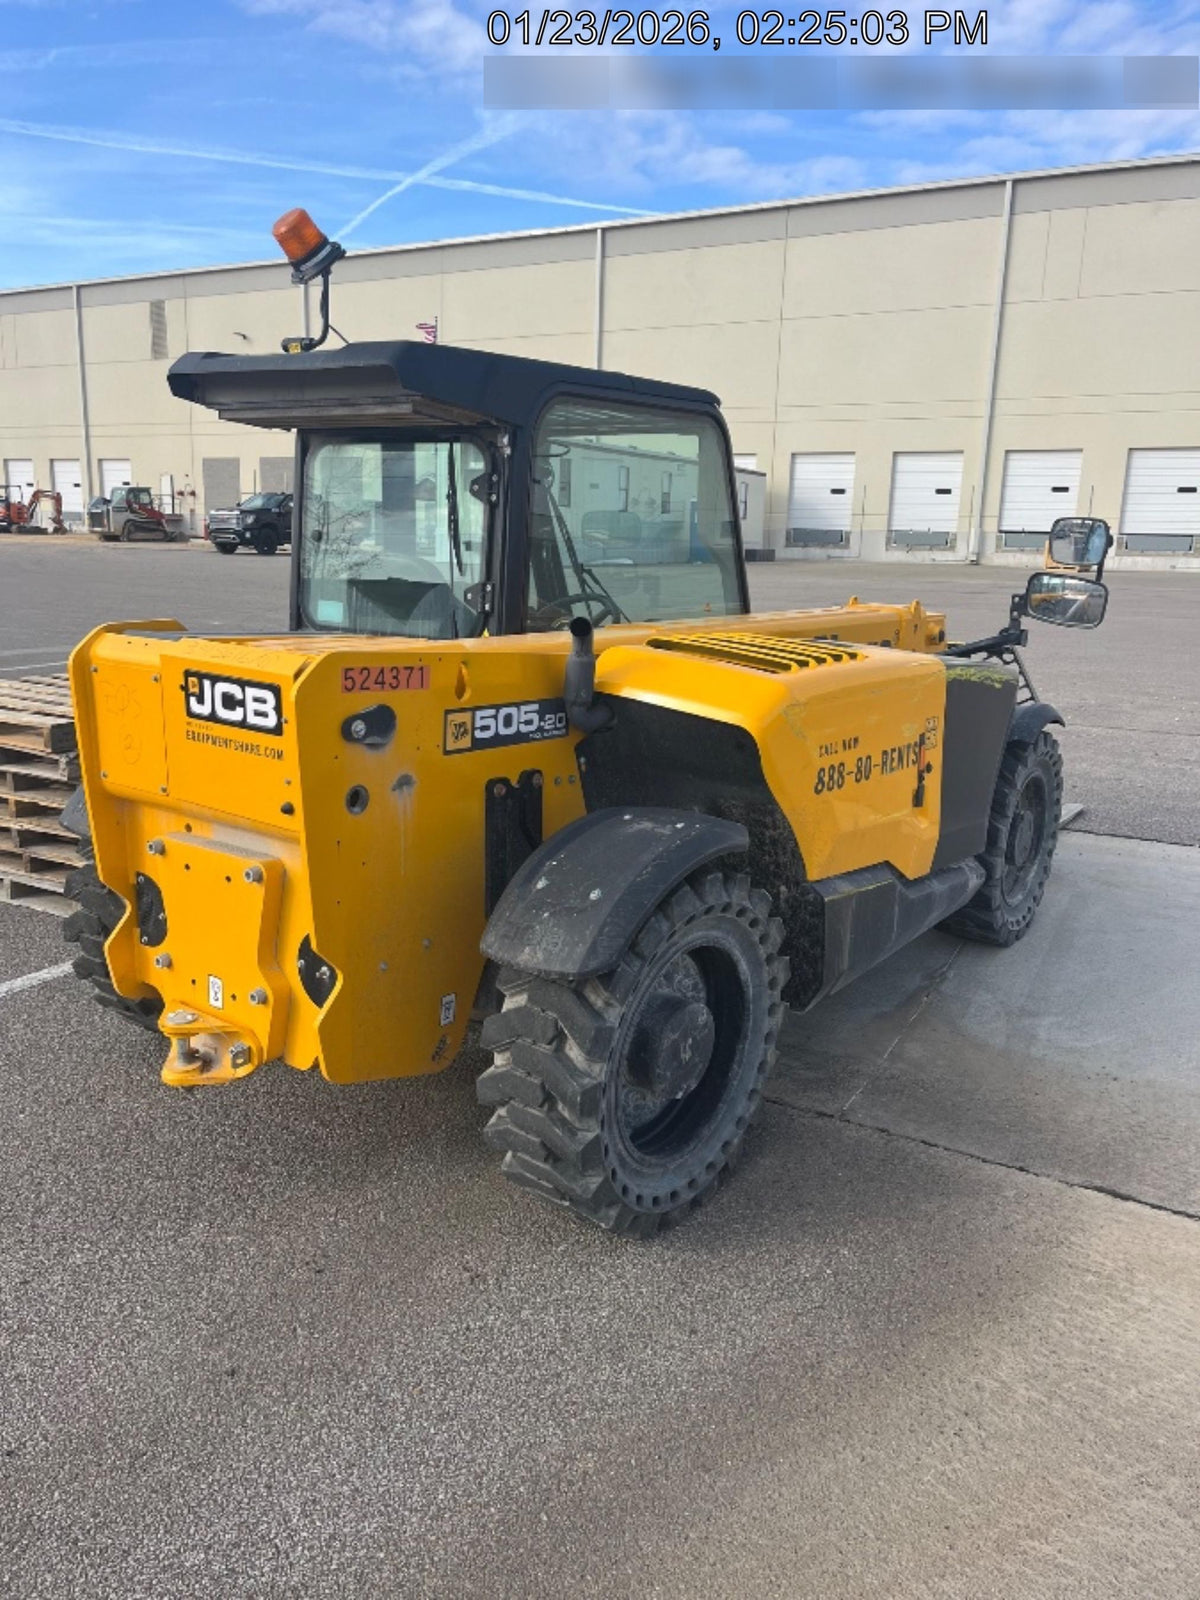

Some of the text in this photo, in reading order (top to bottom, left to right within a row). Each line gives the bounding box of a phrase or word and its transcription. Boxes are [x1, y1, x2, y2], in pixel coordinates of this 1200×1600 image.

[343, 666, 424, 692] 524371
[189, 678, 278, 728] JCB
[186, 729, 284, 760] EQUIPMENTSHARE.COM
[814, 741, 919, 795] 888-80-RENTS
